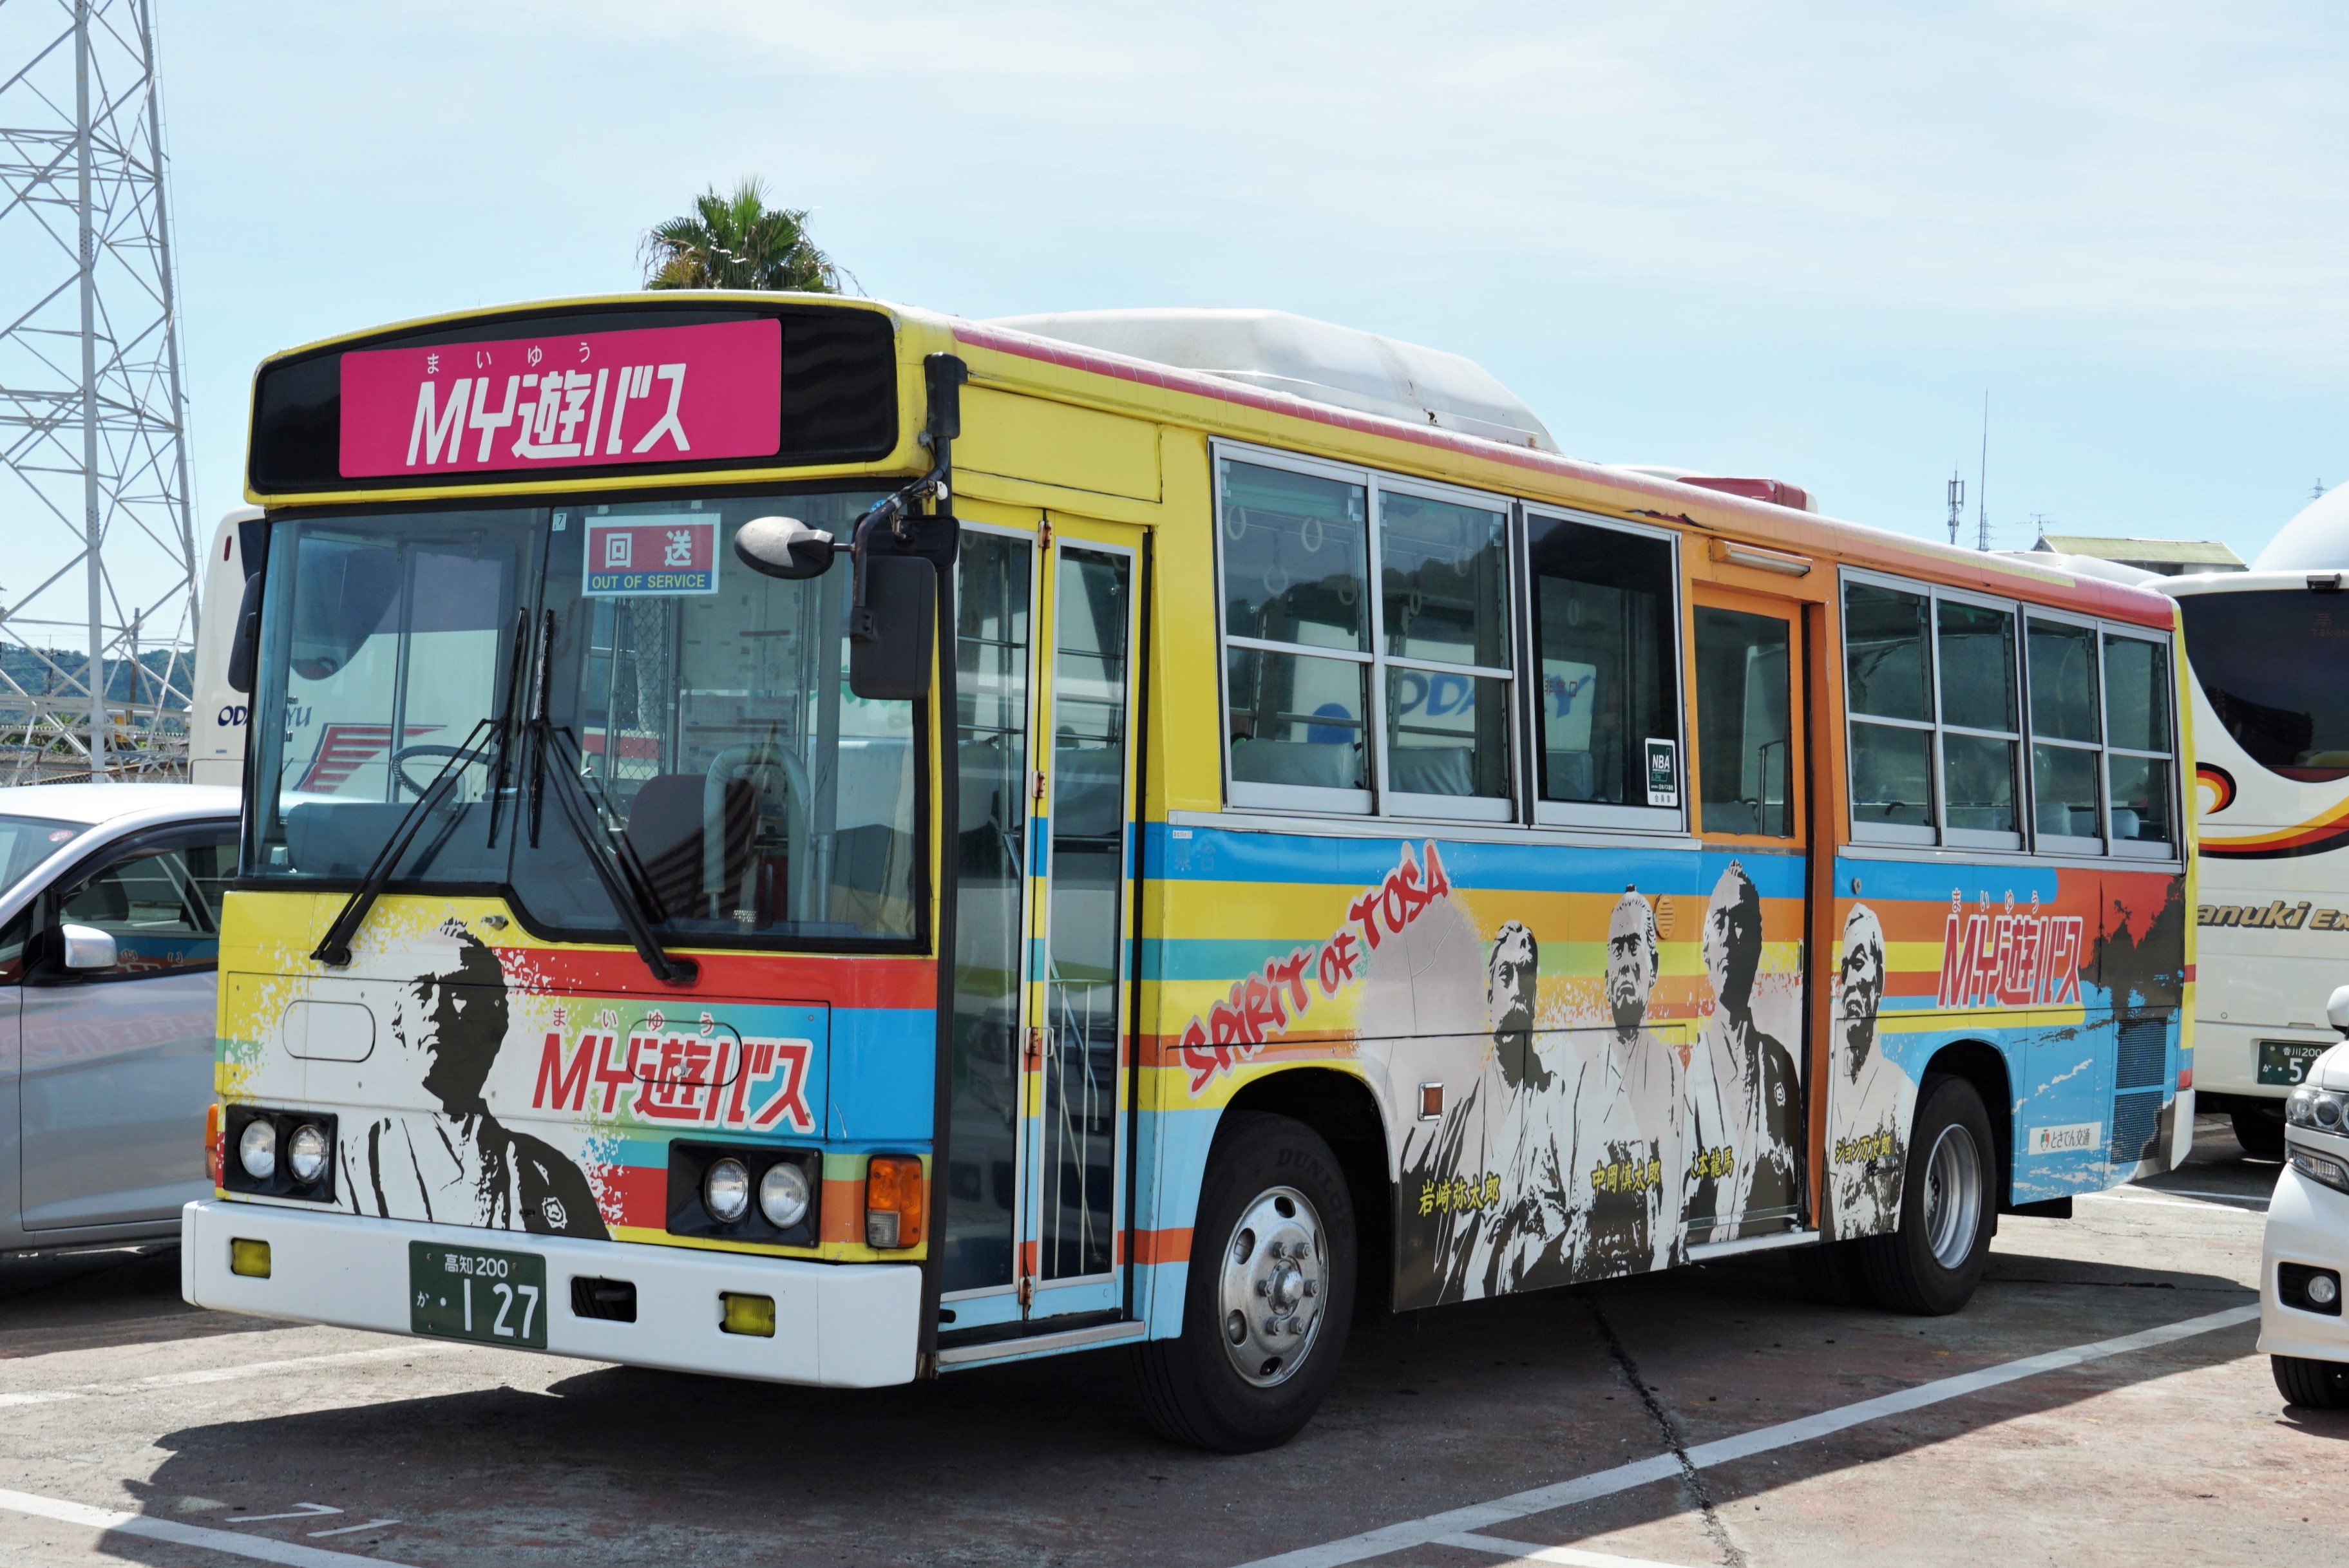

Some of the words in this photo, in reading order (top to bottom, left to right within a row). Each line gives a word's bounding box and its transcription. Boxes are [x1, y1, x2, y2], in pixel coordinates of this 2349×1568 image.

[406, 363, 690, 466] MY遊バス
[605, 530, 692, 568] 回送
[592, 576, 618, 589] OUT
[623, 575, 642, 589] OF
[648, 574, 705, 589] SERVICE
[1653, 754, 1670, 769] NBA
[1320, 932, 1358, 994] OF
[1349, 845, 1448, 950] TOSA
[1937, 917, 2082, 1008] MY遊バス
[531, 1032, 810, 1127] MY遊バス
[1836, 1132, 1892, 1162] ジョン万次郎
[2051, 1128, 2090, 1148] とさでん交通
[1418, 1173, 1500, 1217] 岩崎弥太郎
[1592, 1158, 1660, 1197] 中岡慎太郎
[417, 1290, 430, 1308] か
